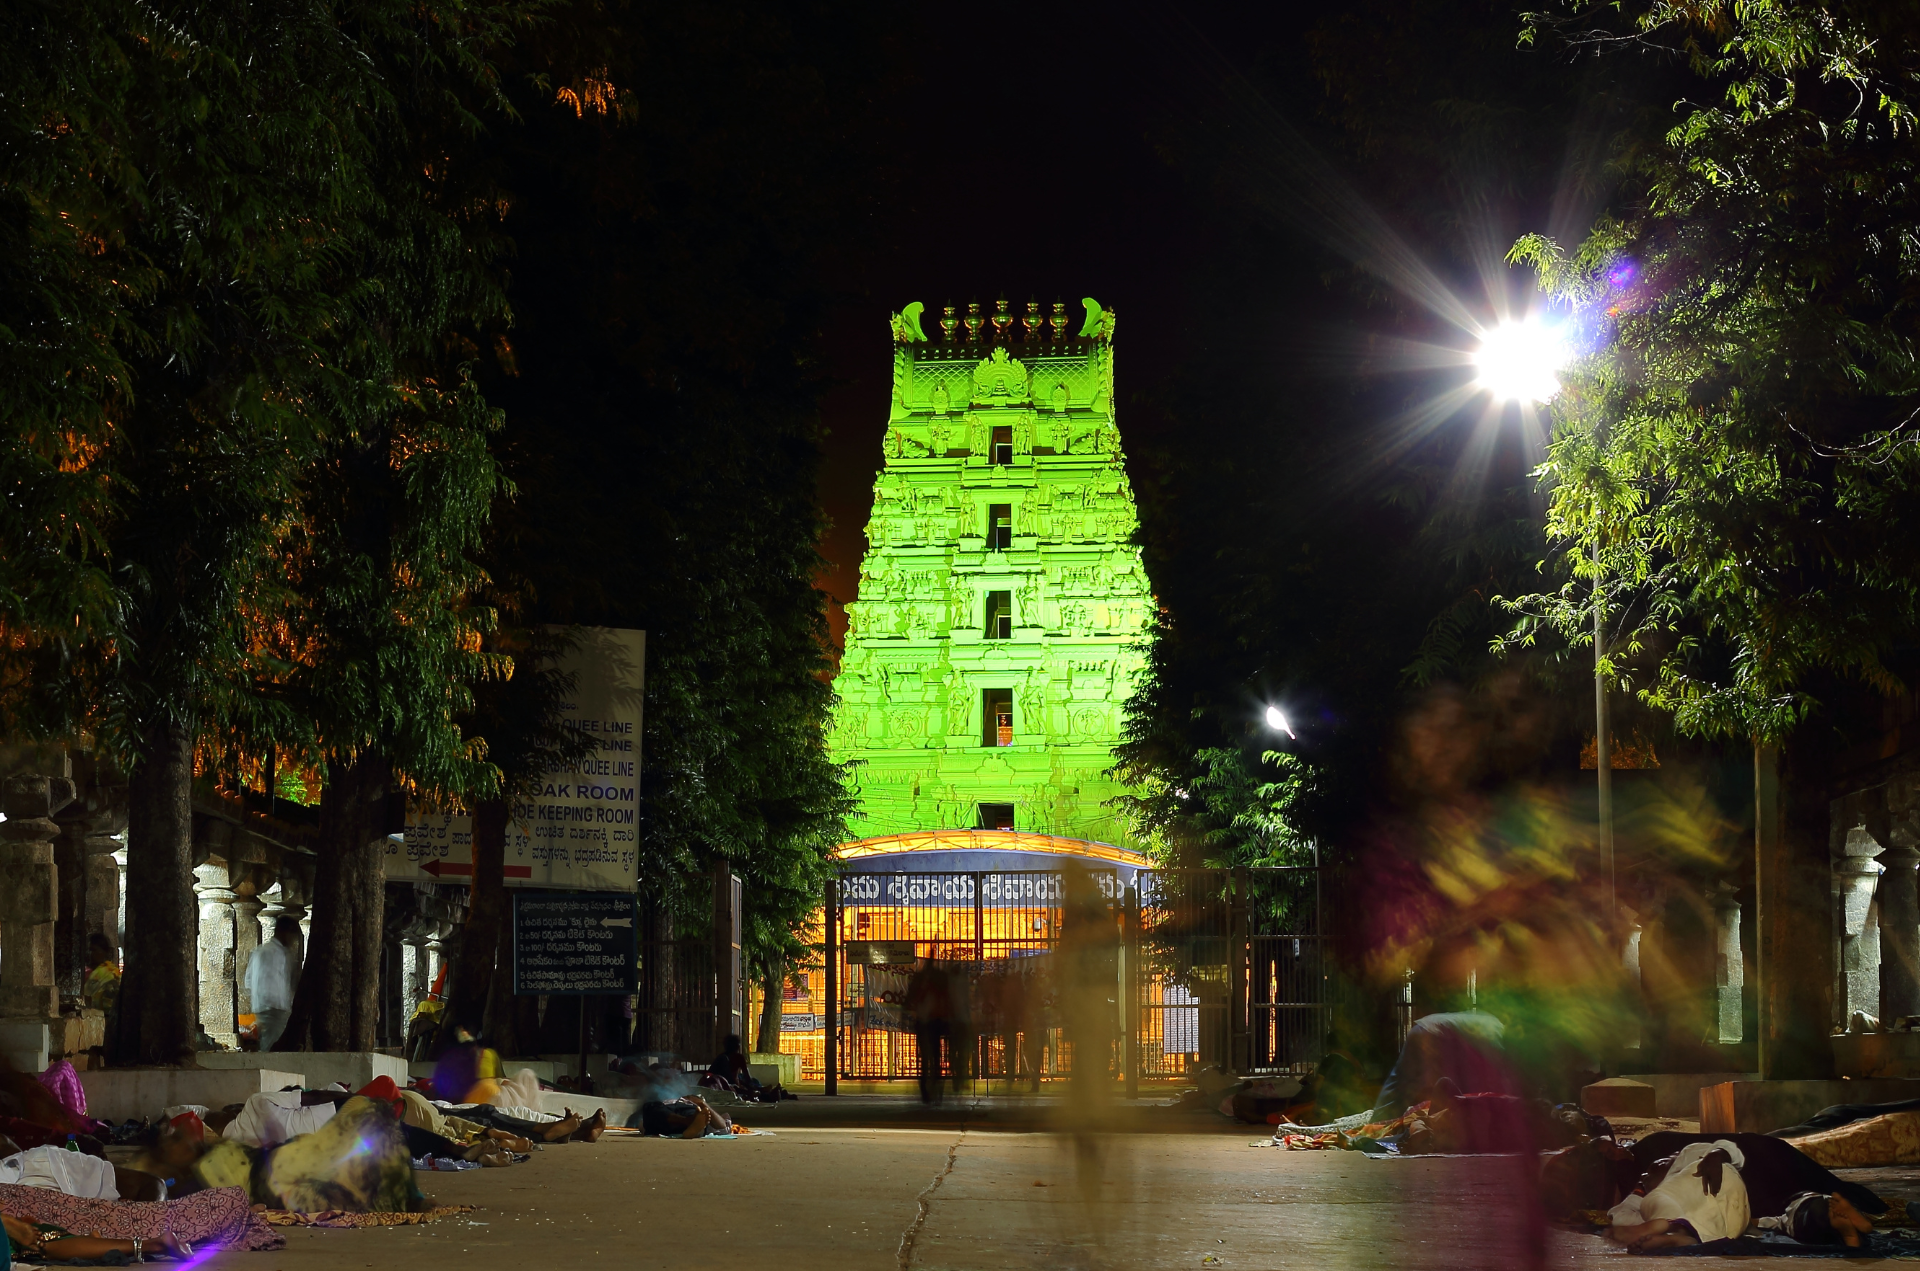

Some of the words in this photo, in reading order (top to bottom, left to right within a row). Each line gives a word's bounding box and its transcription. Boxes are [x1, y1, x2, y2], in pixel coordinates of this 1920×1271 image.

[562, 719, 599, 732] QUEE
[603, 722, 633, 734] LINE
[603, 740, 632, 752] LINE
[583, 760, 610, 776] QUEE
[612, 761, 634, 777] LINE
[531, 782, 571, 798] OAK
[576, 785, 634, 802] ROOM
[511, 803, 535, 820] HOE
[538, 804, 593, 822] KEEPING
[596, 807, 634, 824] ROOM
[535, 825, 565, 838] ಉಚಿತ
[613, 829, 635, 842] ದಾರಿ
[407, 841, 449, 861] ಪ್ರವೇಶ
